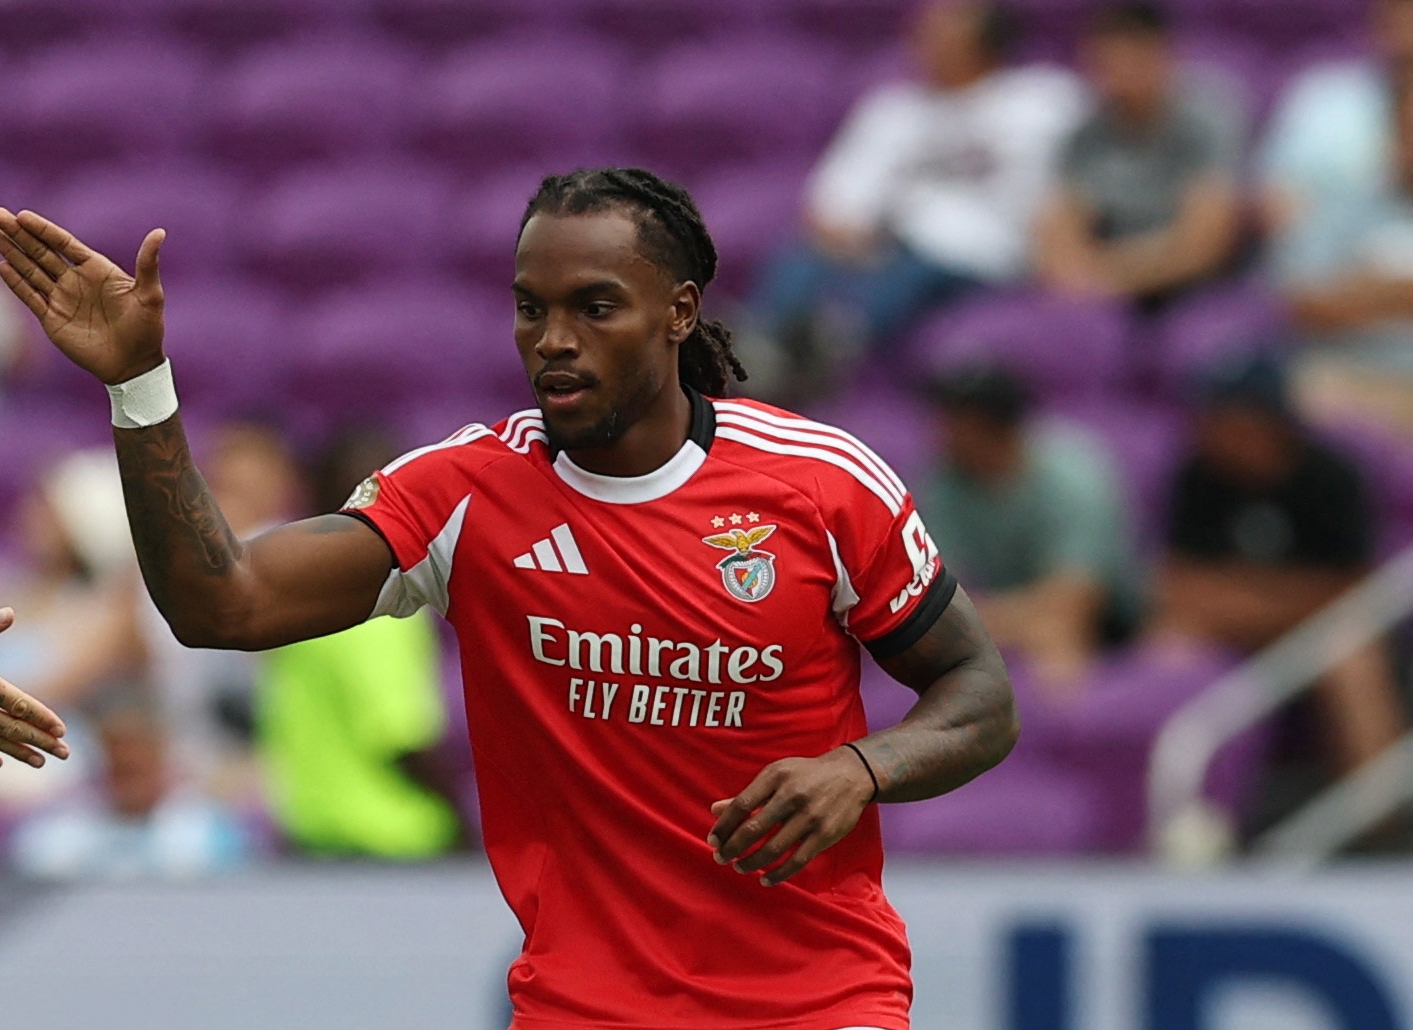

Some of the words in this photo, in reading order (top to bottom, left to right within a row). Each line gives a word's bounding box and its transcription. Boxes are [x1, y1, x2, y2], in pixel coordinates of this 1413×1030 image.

[525, 614, 784, 685] Emirates
[568, 677, 620, 720] FLY
[628, 684, 746, 728] BETTER
